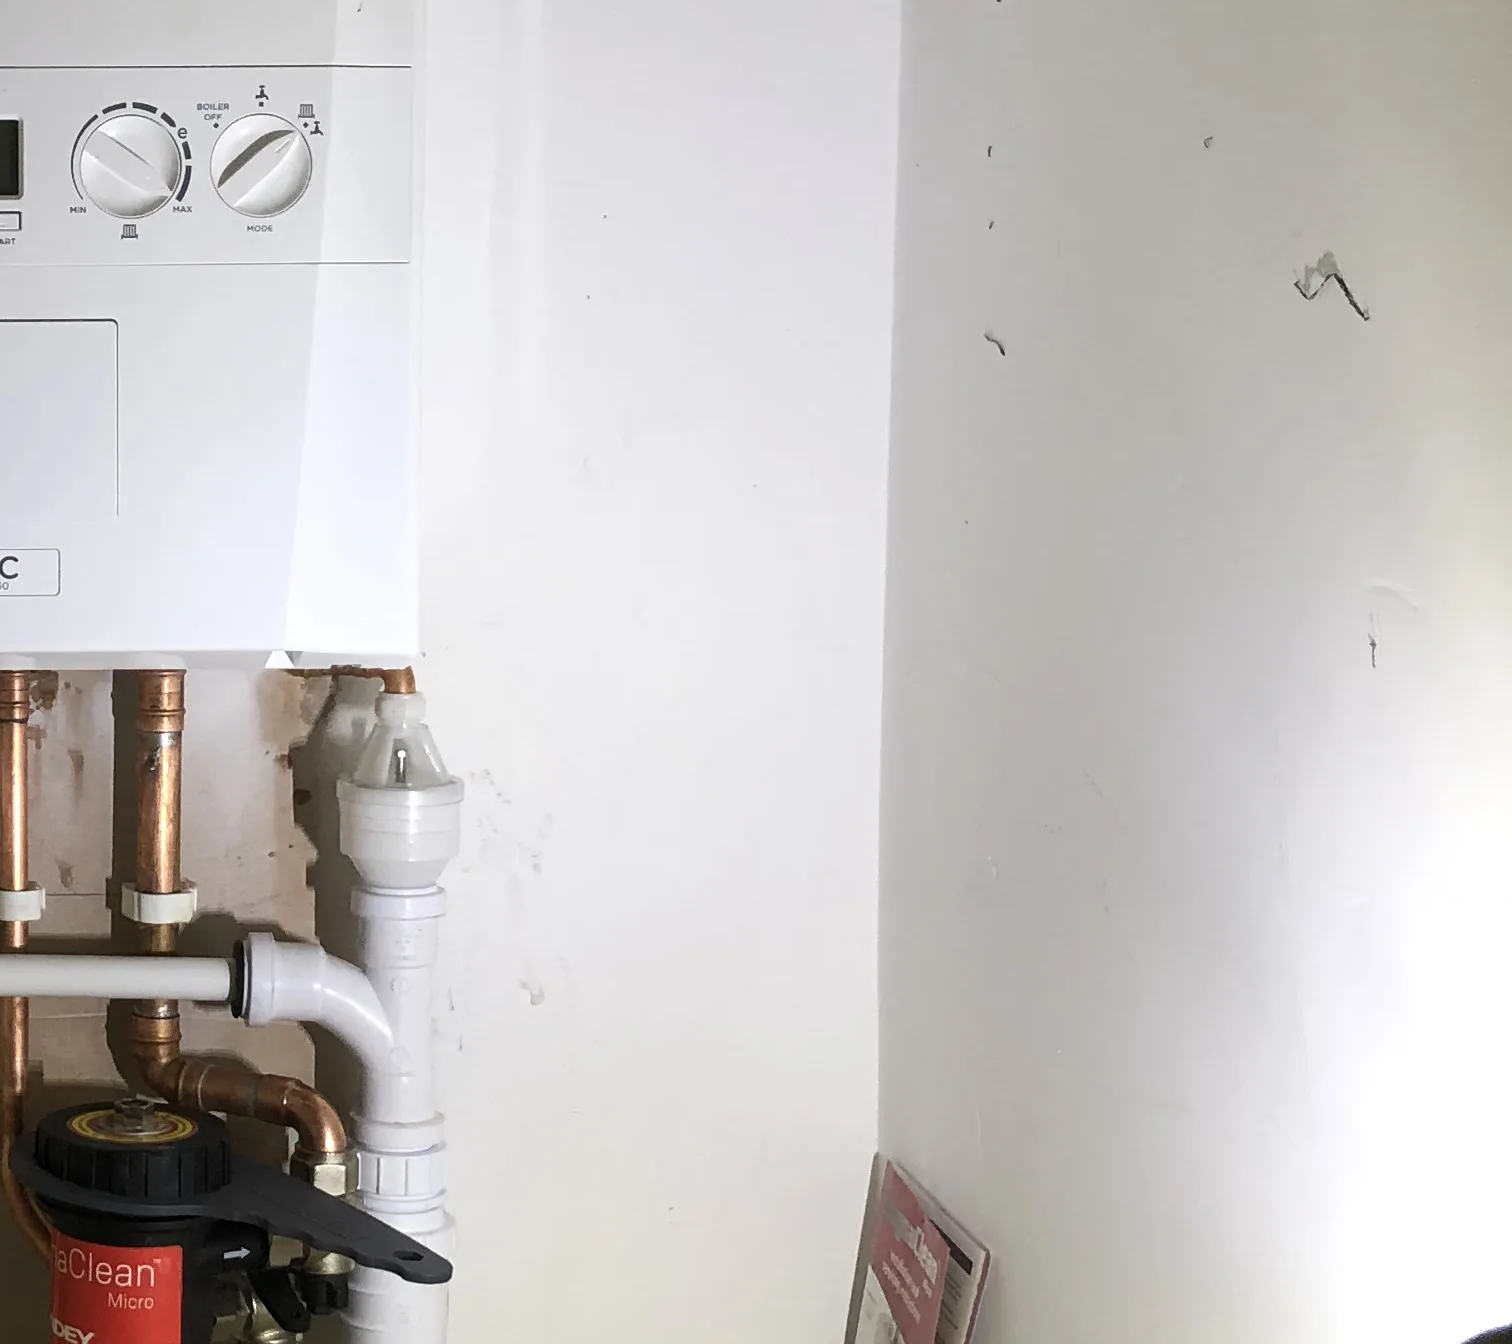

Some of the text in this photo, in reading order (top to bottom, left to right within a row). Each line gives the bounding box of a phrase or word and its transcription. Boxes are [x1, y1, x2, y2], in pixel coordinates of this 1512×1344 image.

[196, 102, 230, 111] BOILER
[203, 113, 223, 121] OFF
[69, 206, 87, 214] MIN
[172, 205, 193, 213] MAX
[247, 224, 273, 232] MODE
[55, 1247, 155, 1287] aClean
[107, 1291, 154, 1310] Micro
